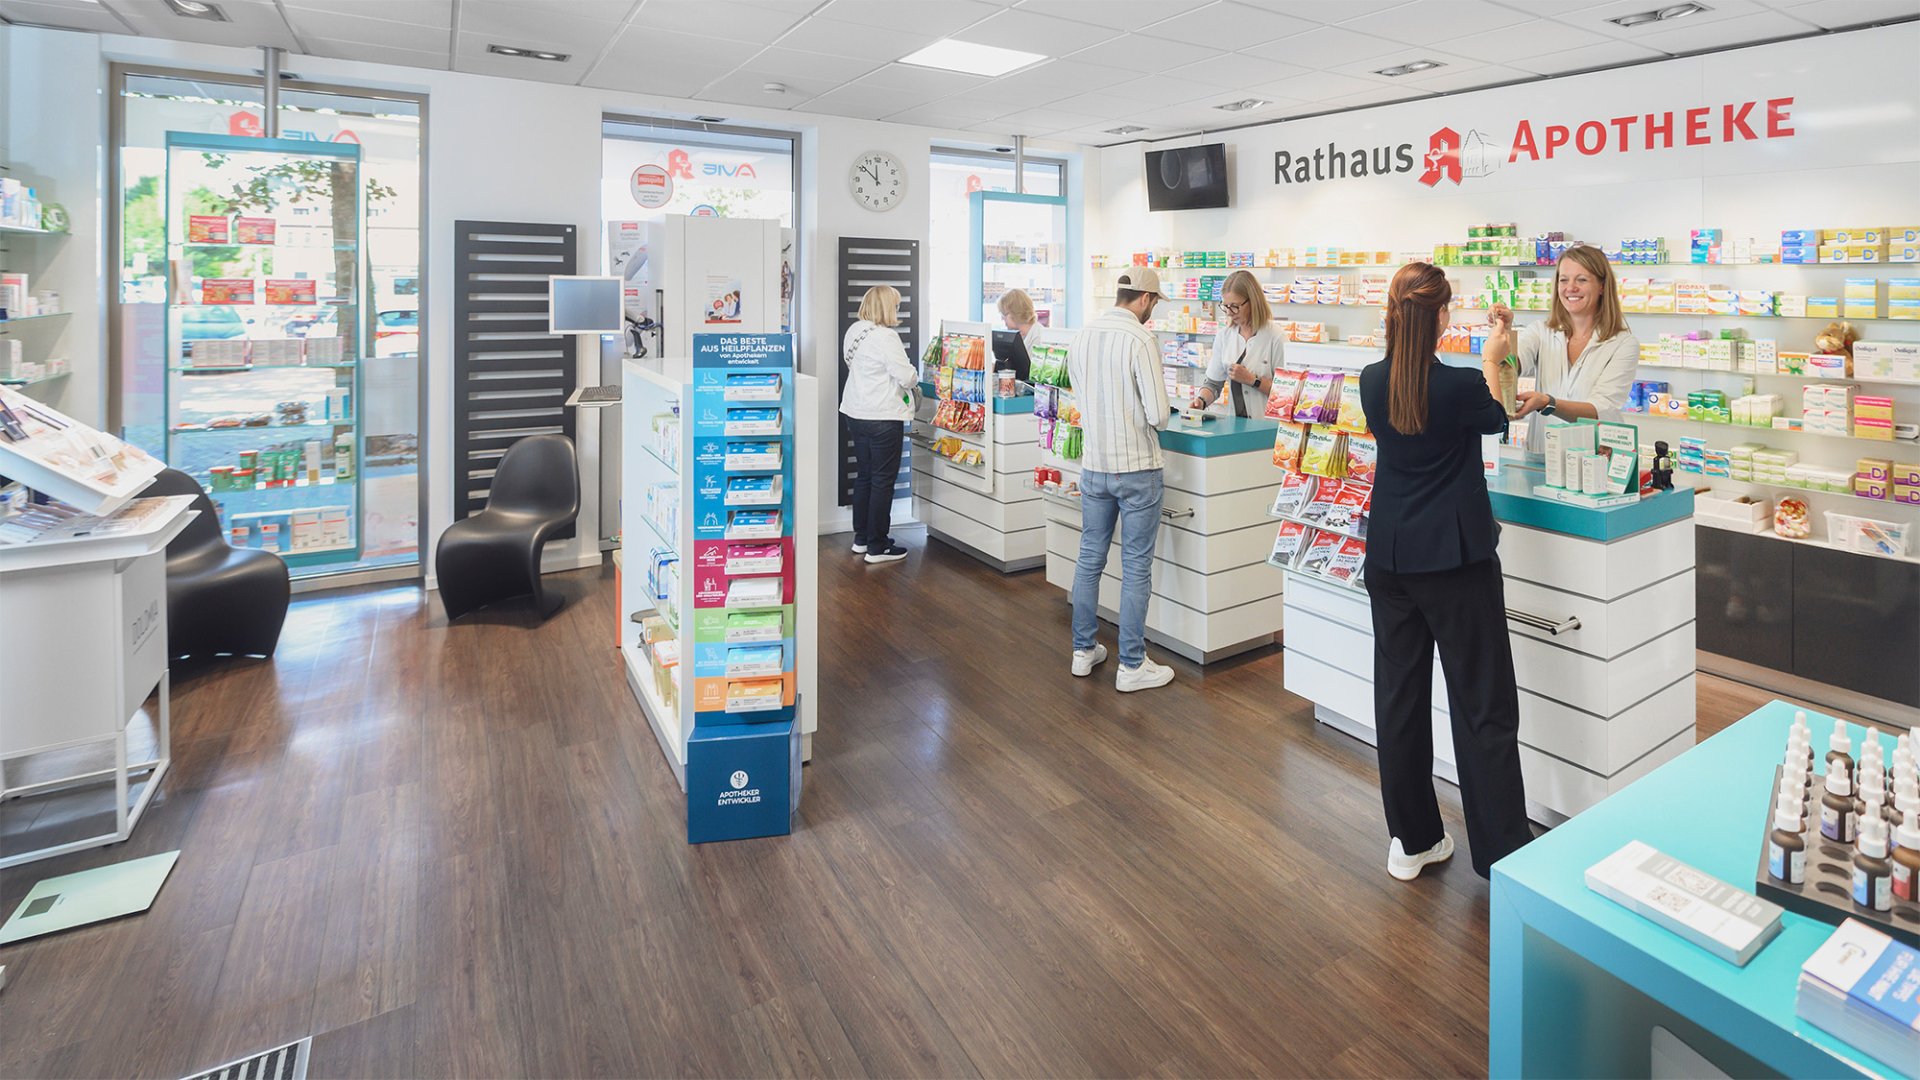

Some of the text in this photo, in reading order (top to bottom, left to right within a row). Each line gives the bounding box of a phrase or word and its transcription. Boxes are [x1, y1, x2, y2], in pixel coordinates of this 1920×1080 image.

[1274, 142, 1414, 186] Rathaus
[1508, 97, 1795, 164] APOTHEKE
[719, 789, 760, 798] APOTHEKER
[718, 796, 761, 806] ENTWICKLER
